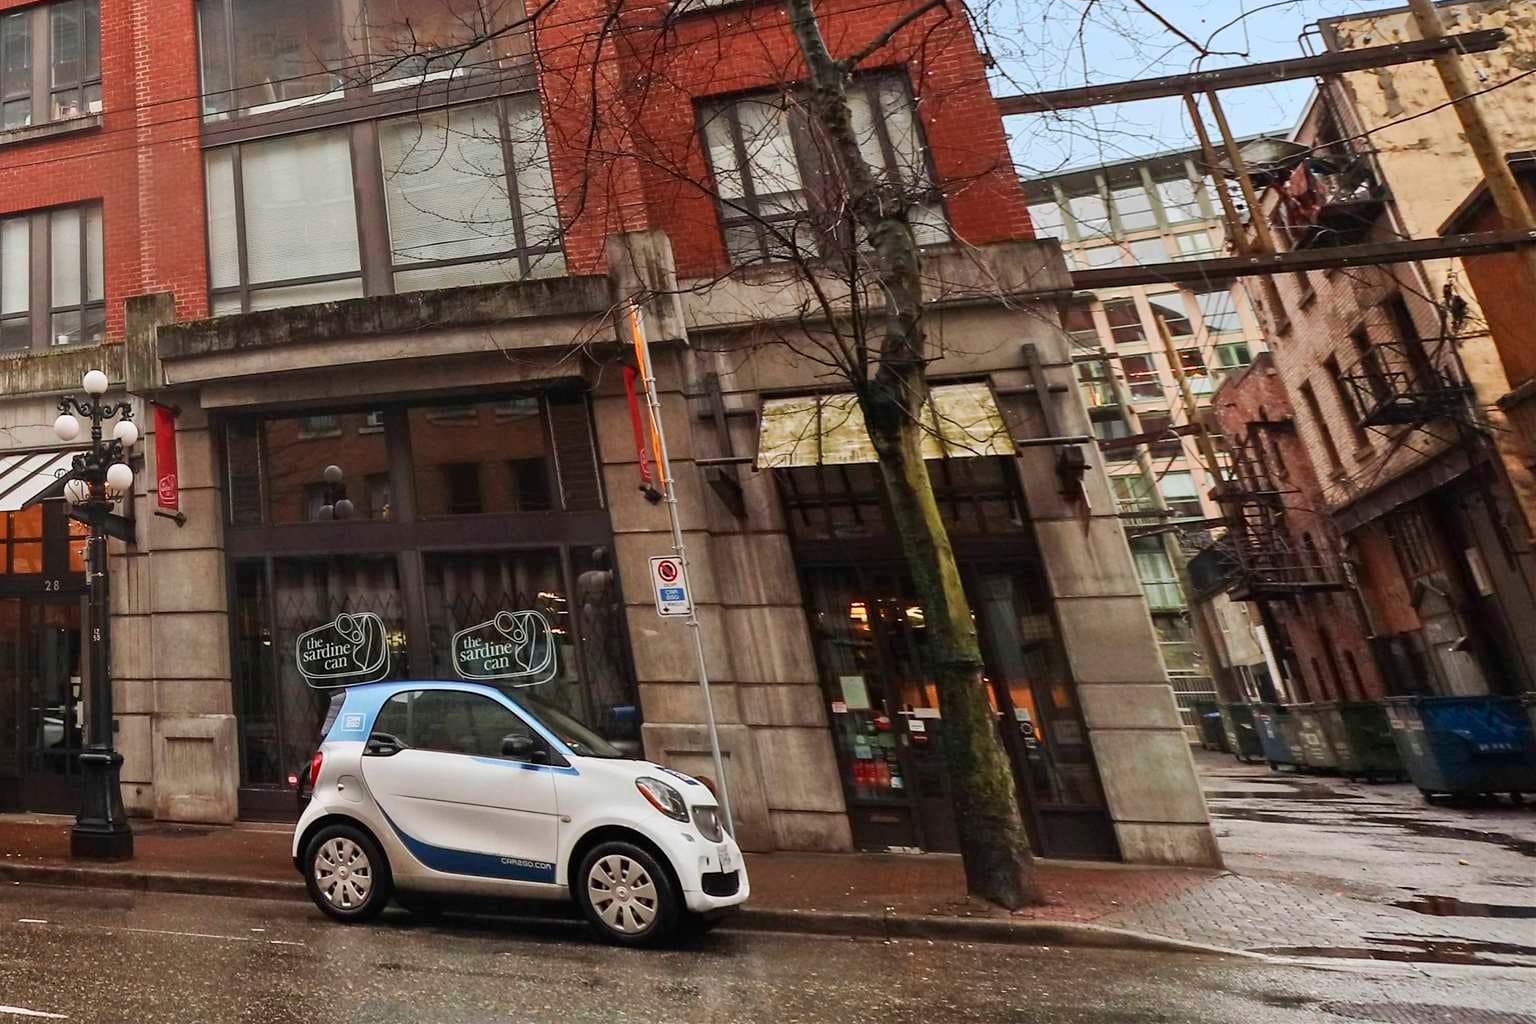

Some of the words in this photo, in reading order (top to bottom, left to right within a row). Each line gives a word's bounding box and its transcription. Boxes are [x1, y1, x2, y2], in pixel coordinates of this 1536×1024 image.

[44, 580, 60, 592] 28
[306, 637, 323, 650] the
[464, 636, 482, 649] the
[304, 642, 352, 663] sardine
[460, 641, 513, 663] sardine
[324, 656, 348, 670] can
[484, 656, 510, 671] can
